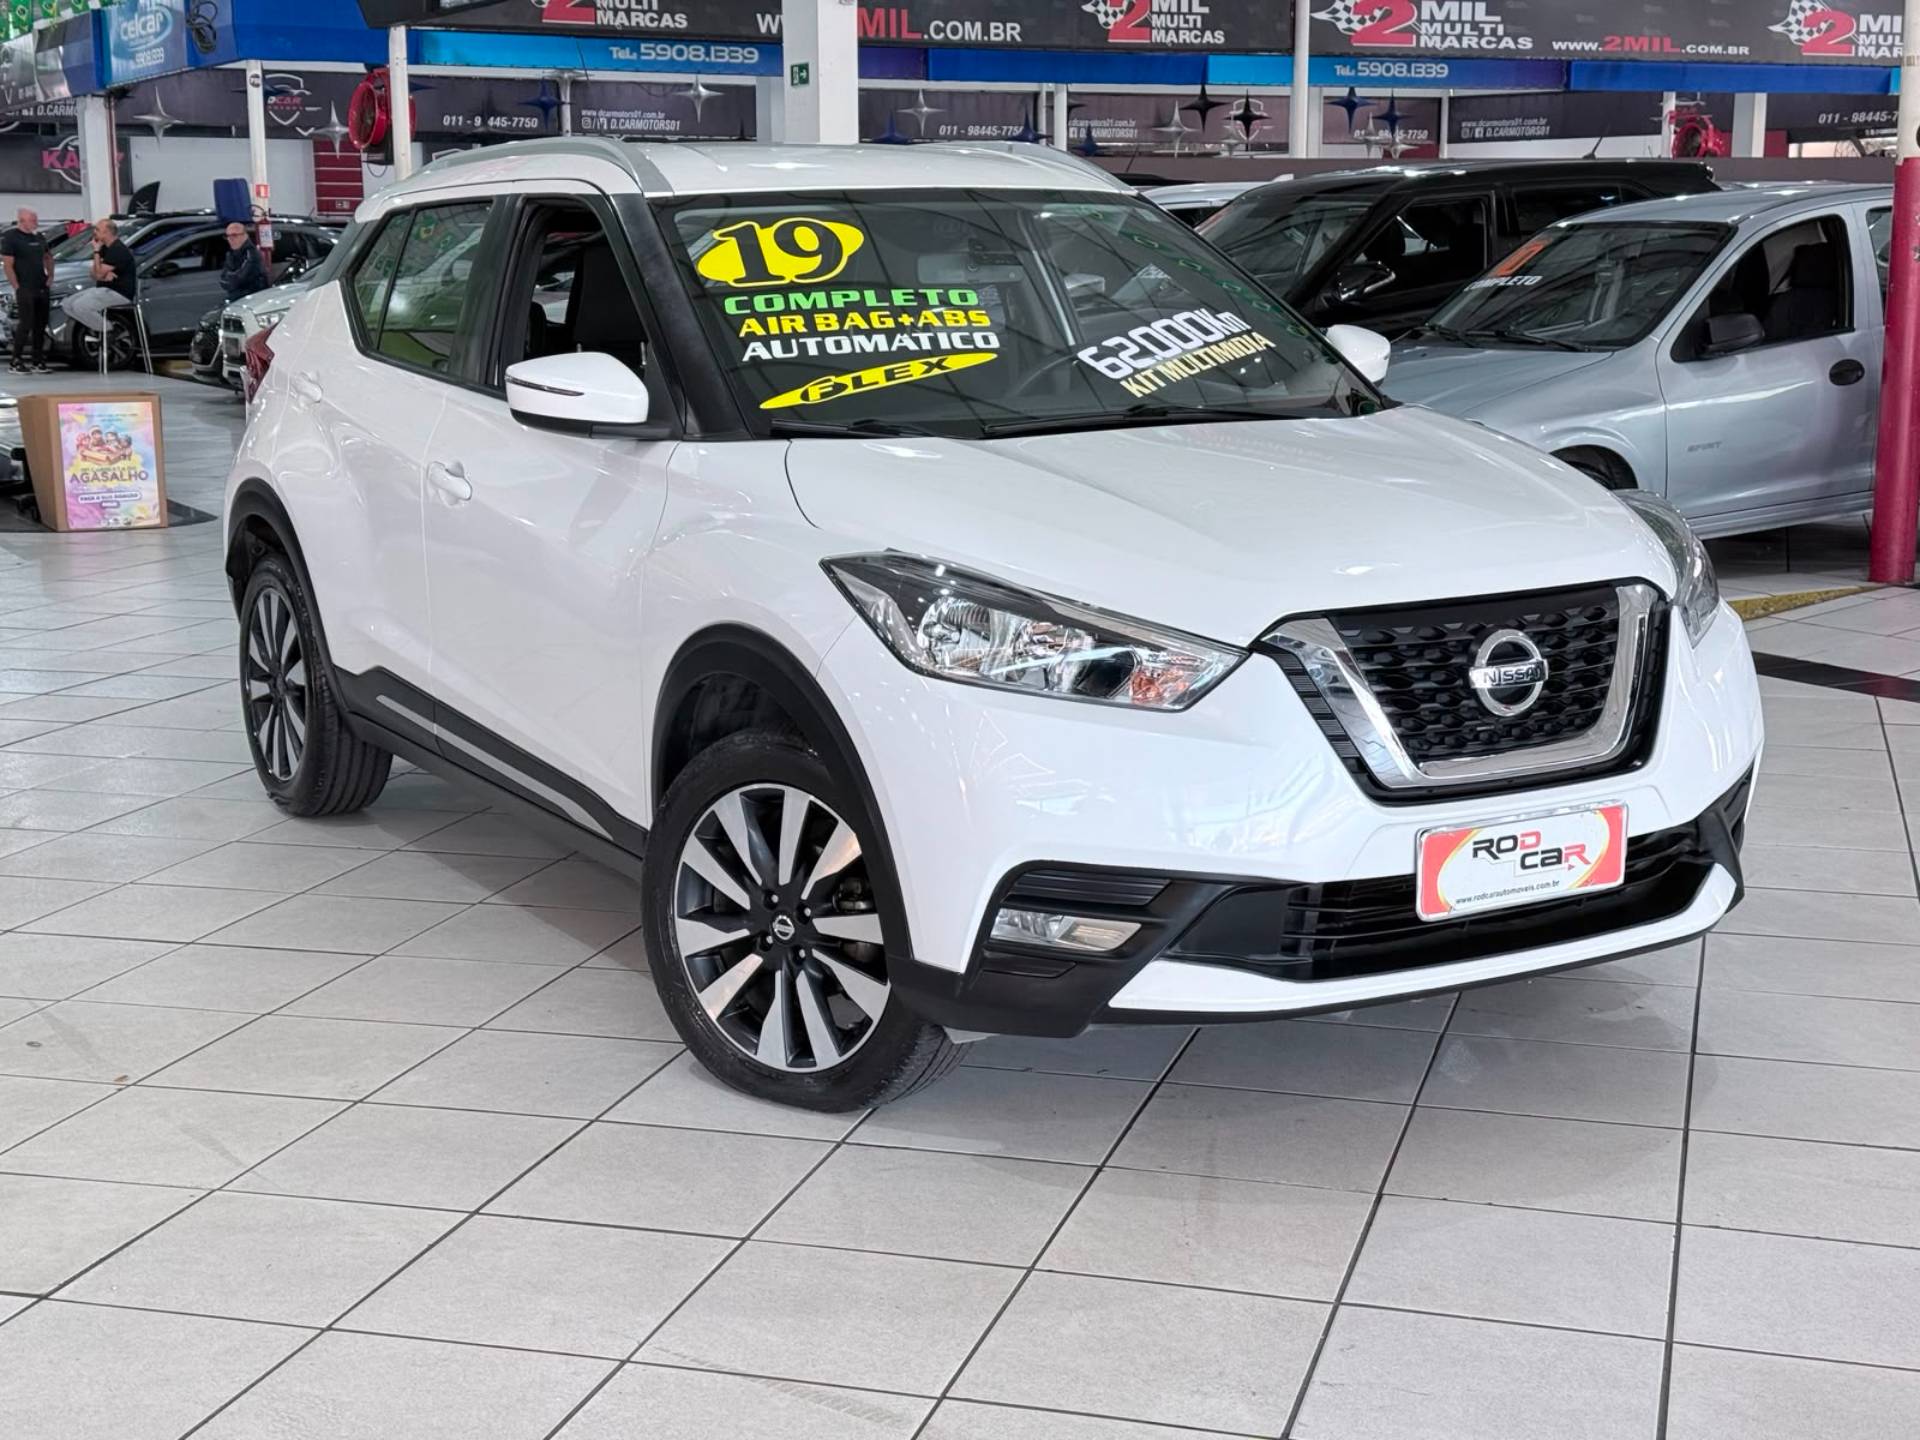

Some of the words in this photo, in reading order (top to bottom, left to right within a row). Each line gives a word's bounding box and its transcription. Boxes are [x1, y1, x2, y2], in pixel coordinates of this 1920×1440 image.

[596, 11, 688, 29] MARCAS
[1151, 14, 1202, 28] MULTI
[1350, 0, 1417, 47] 2
[1421, 0, 1502, 21] MIL
[1151, 29, 1225, 44] MARCAS
[1421, 23, 1504, 36] MULTI
[1802, 9, 1856, 56] 2
[1420, 36, 1533, 49] MARCAS
[443, 115, 463, 126] 011
[474, 116, 538, 128] 9445-7750
[610, 118, 680, 131] D.CARMOTORS01
[1818, 113, 1840, 124] 011
[939, 125, 958, 136] 011
[711, 217, 848, 287] 19
[724, 288, 979, 316] COMPLETO
[739, 315, 808, 338] AIR
[815, 310, 991, 332] BAG+ABS
[802, 356, 953, 404] FLEX
[1119, 368, 1167, 398] KIT
[70, 470, 149, 484] AGASALHO
[1472, 830, 1541, 861] ROD
[1455, 879, 1560, 905] www.rodcarautomoveis.com.br
